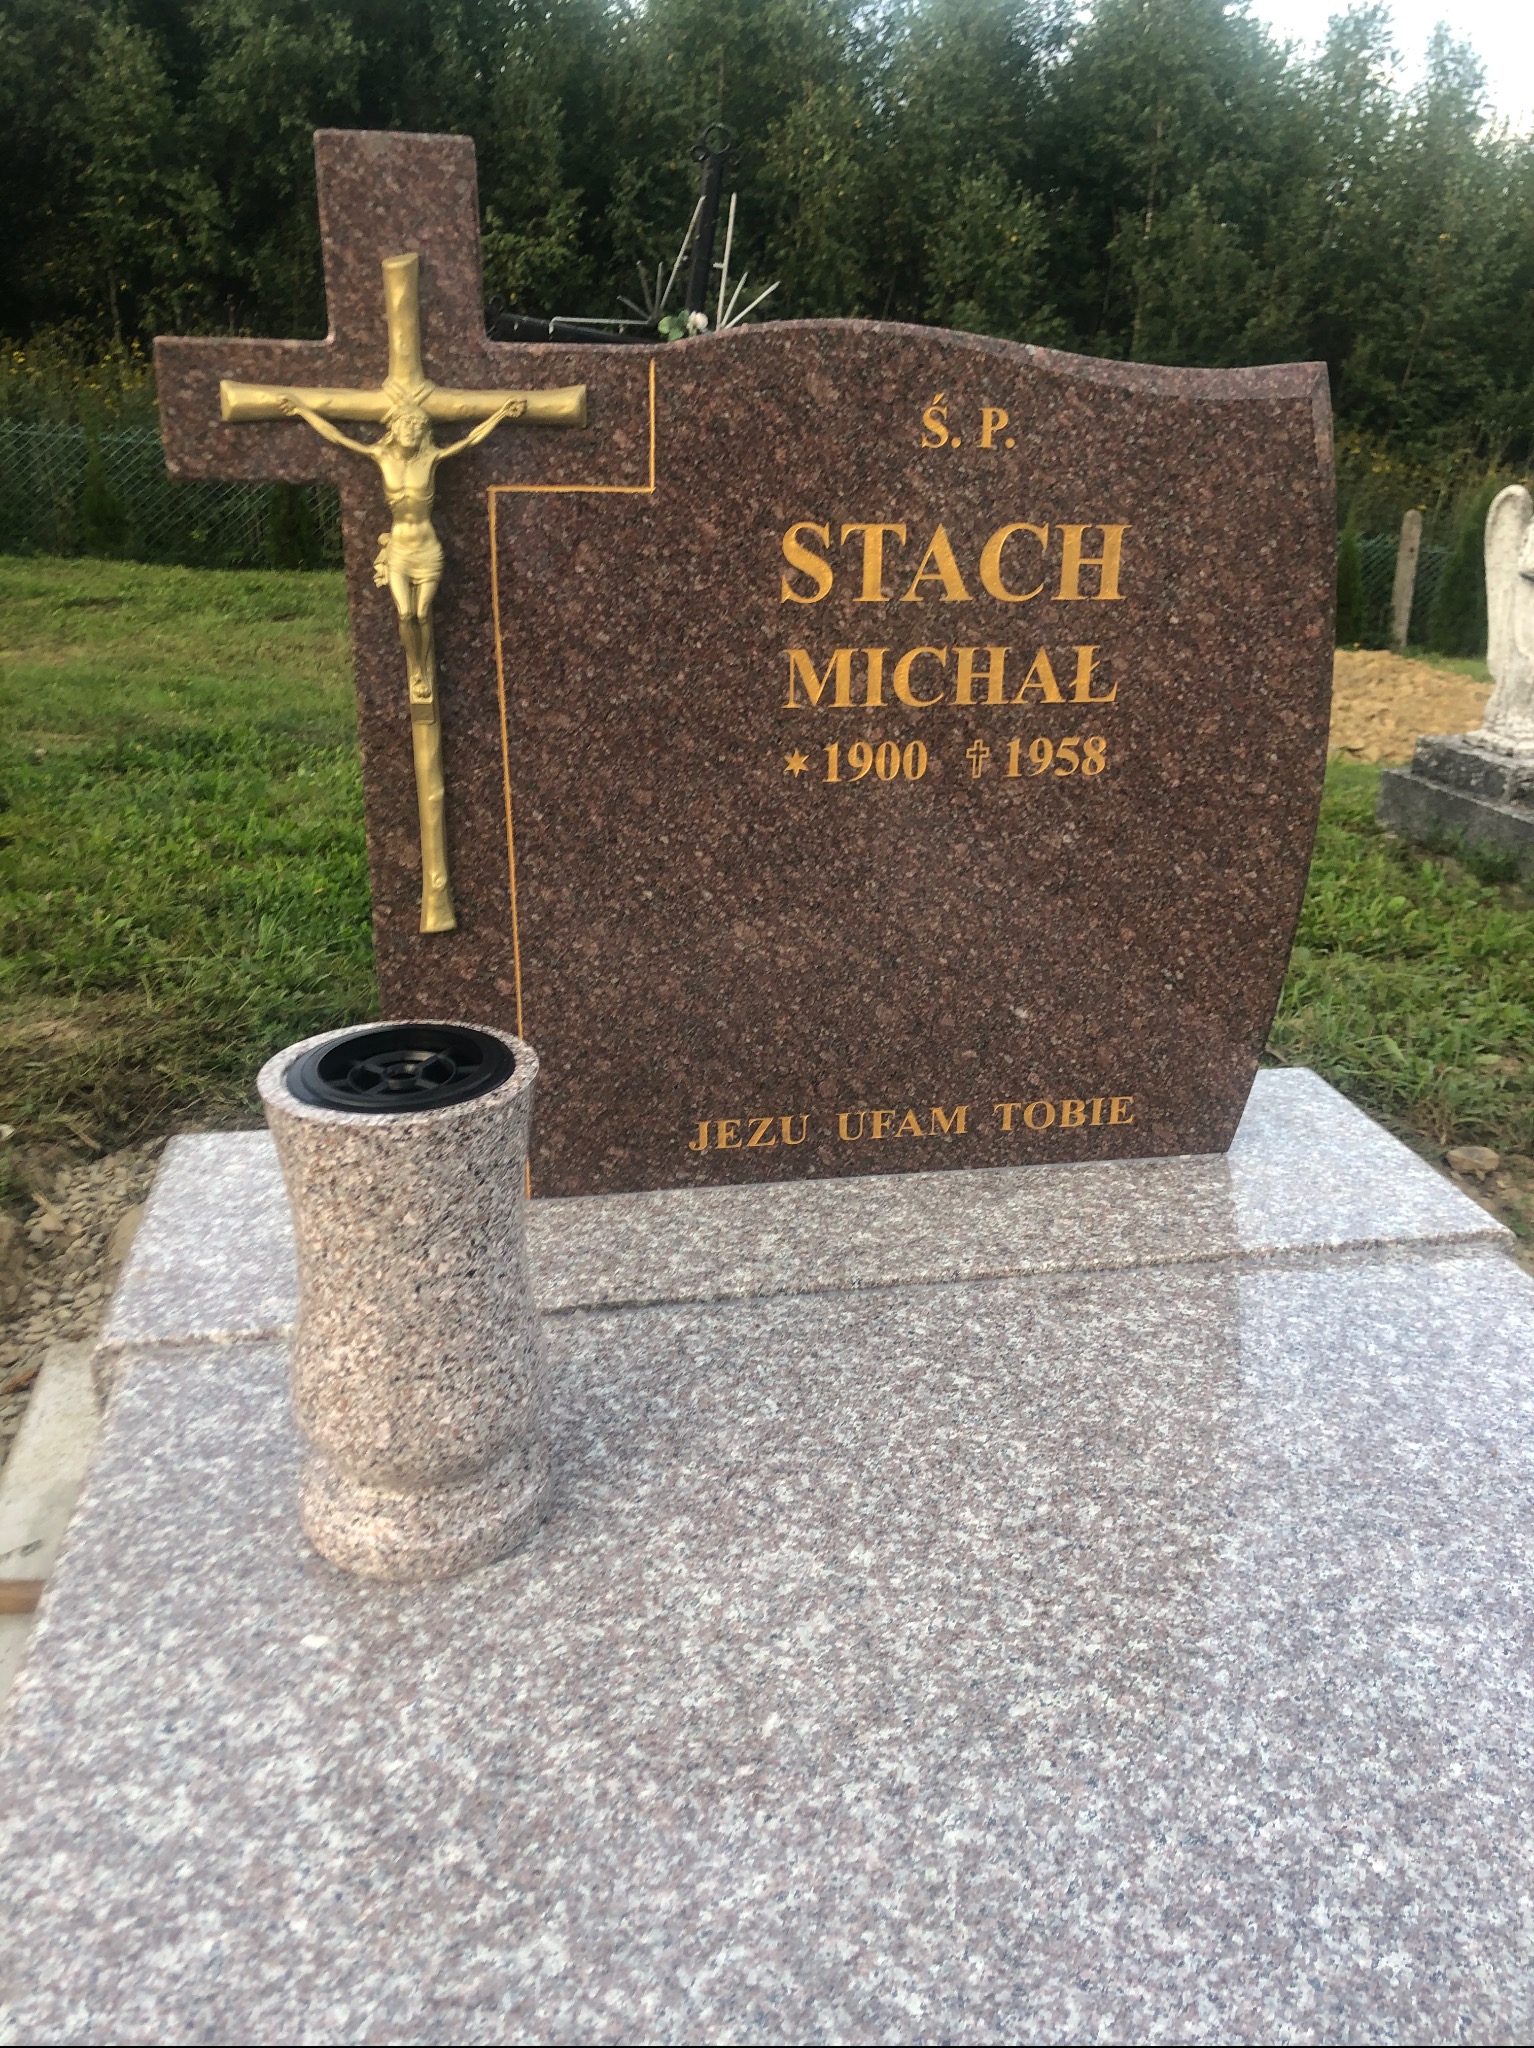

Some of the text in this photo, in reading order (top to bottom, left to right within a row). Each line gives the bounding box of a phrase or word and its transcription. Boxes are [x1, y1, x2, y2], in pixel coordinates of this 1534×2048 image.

[921, 393, 1016, 449] Ś. P.
[781, 521, 1132, 604] STACH
[781, 645, 1118, 709] MICHAŁ
[822, 736, 1107, 783] 1900 1958
[688, 1096, 1136, 1151] JEZU UFAM TOBIE
